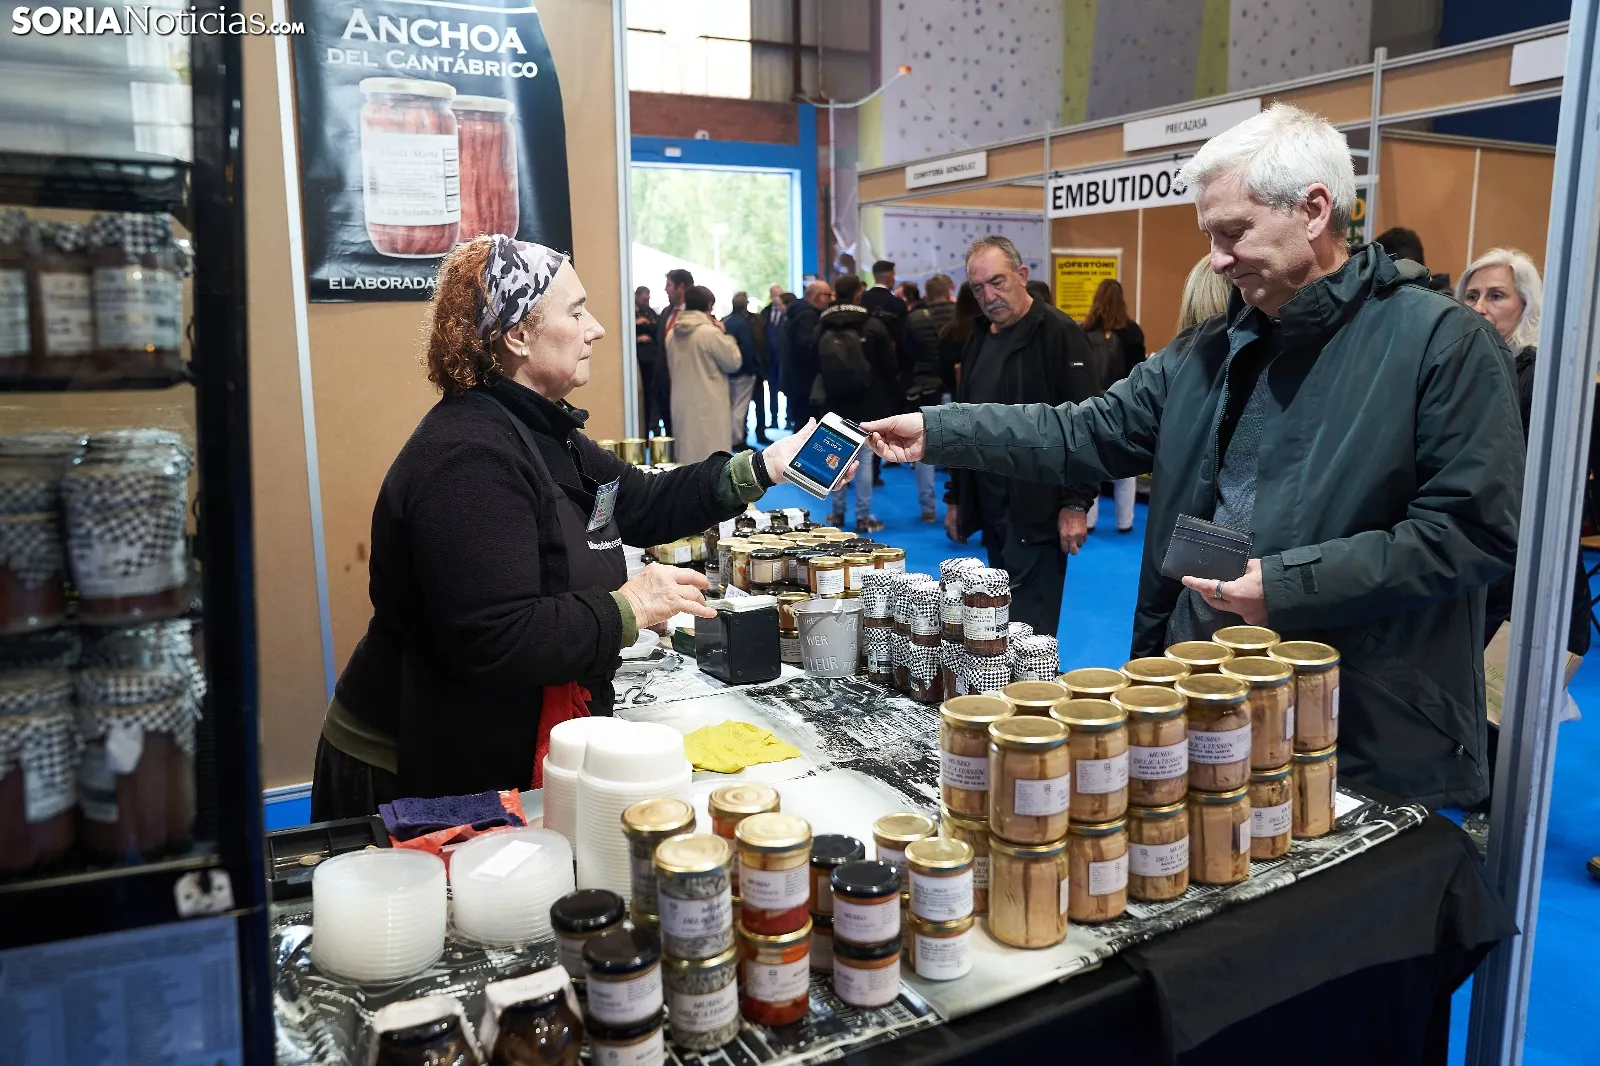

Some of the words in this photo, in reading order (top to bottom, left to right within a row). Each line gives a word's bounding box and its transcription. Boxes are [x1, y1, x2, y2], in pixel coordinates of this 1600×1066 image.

[341, 8, 528, 55] ANCHOA
[327, 48, 379, 67] DEL
[386, 50, 538, 78] CANTÁBRICO
